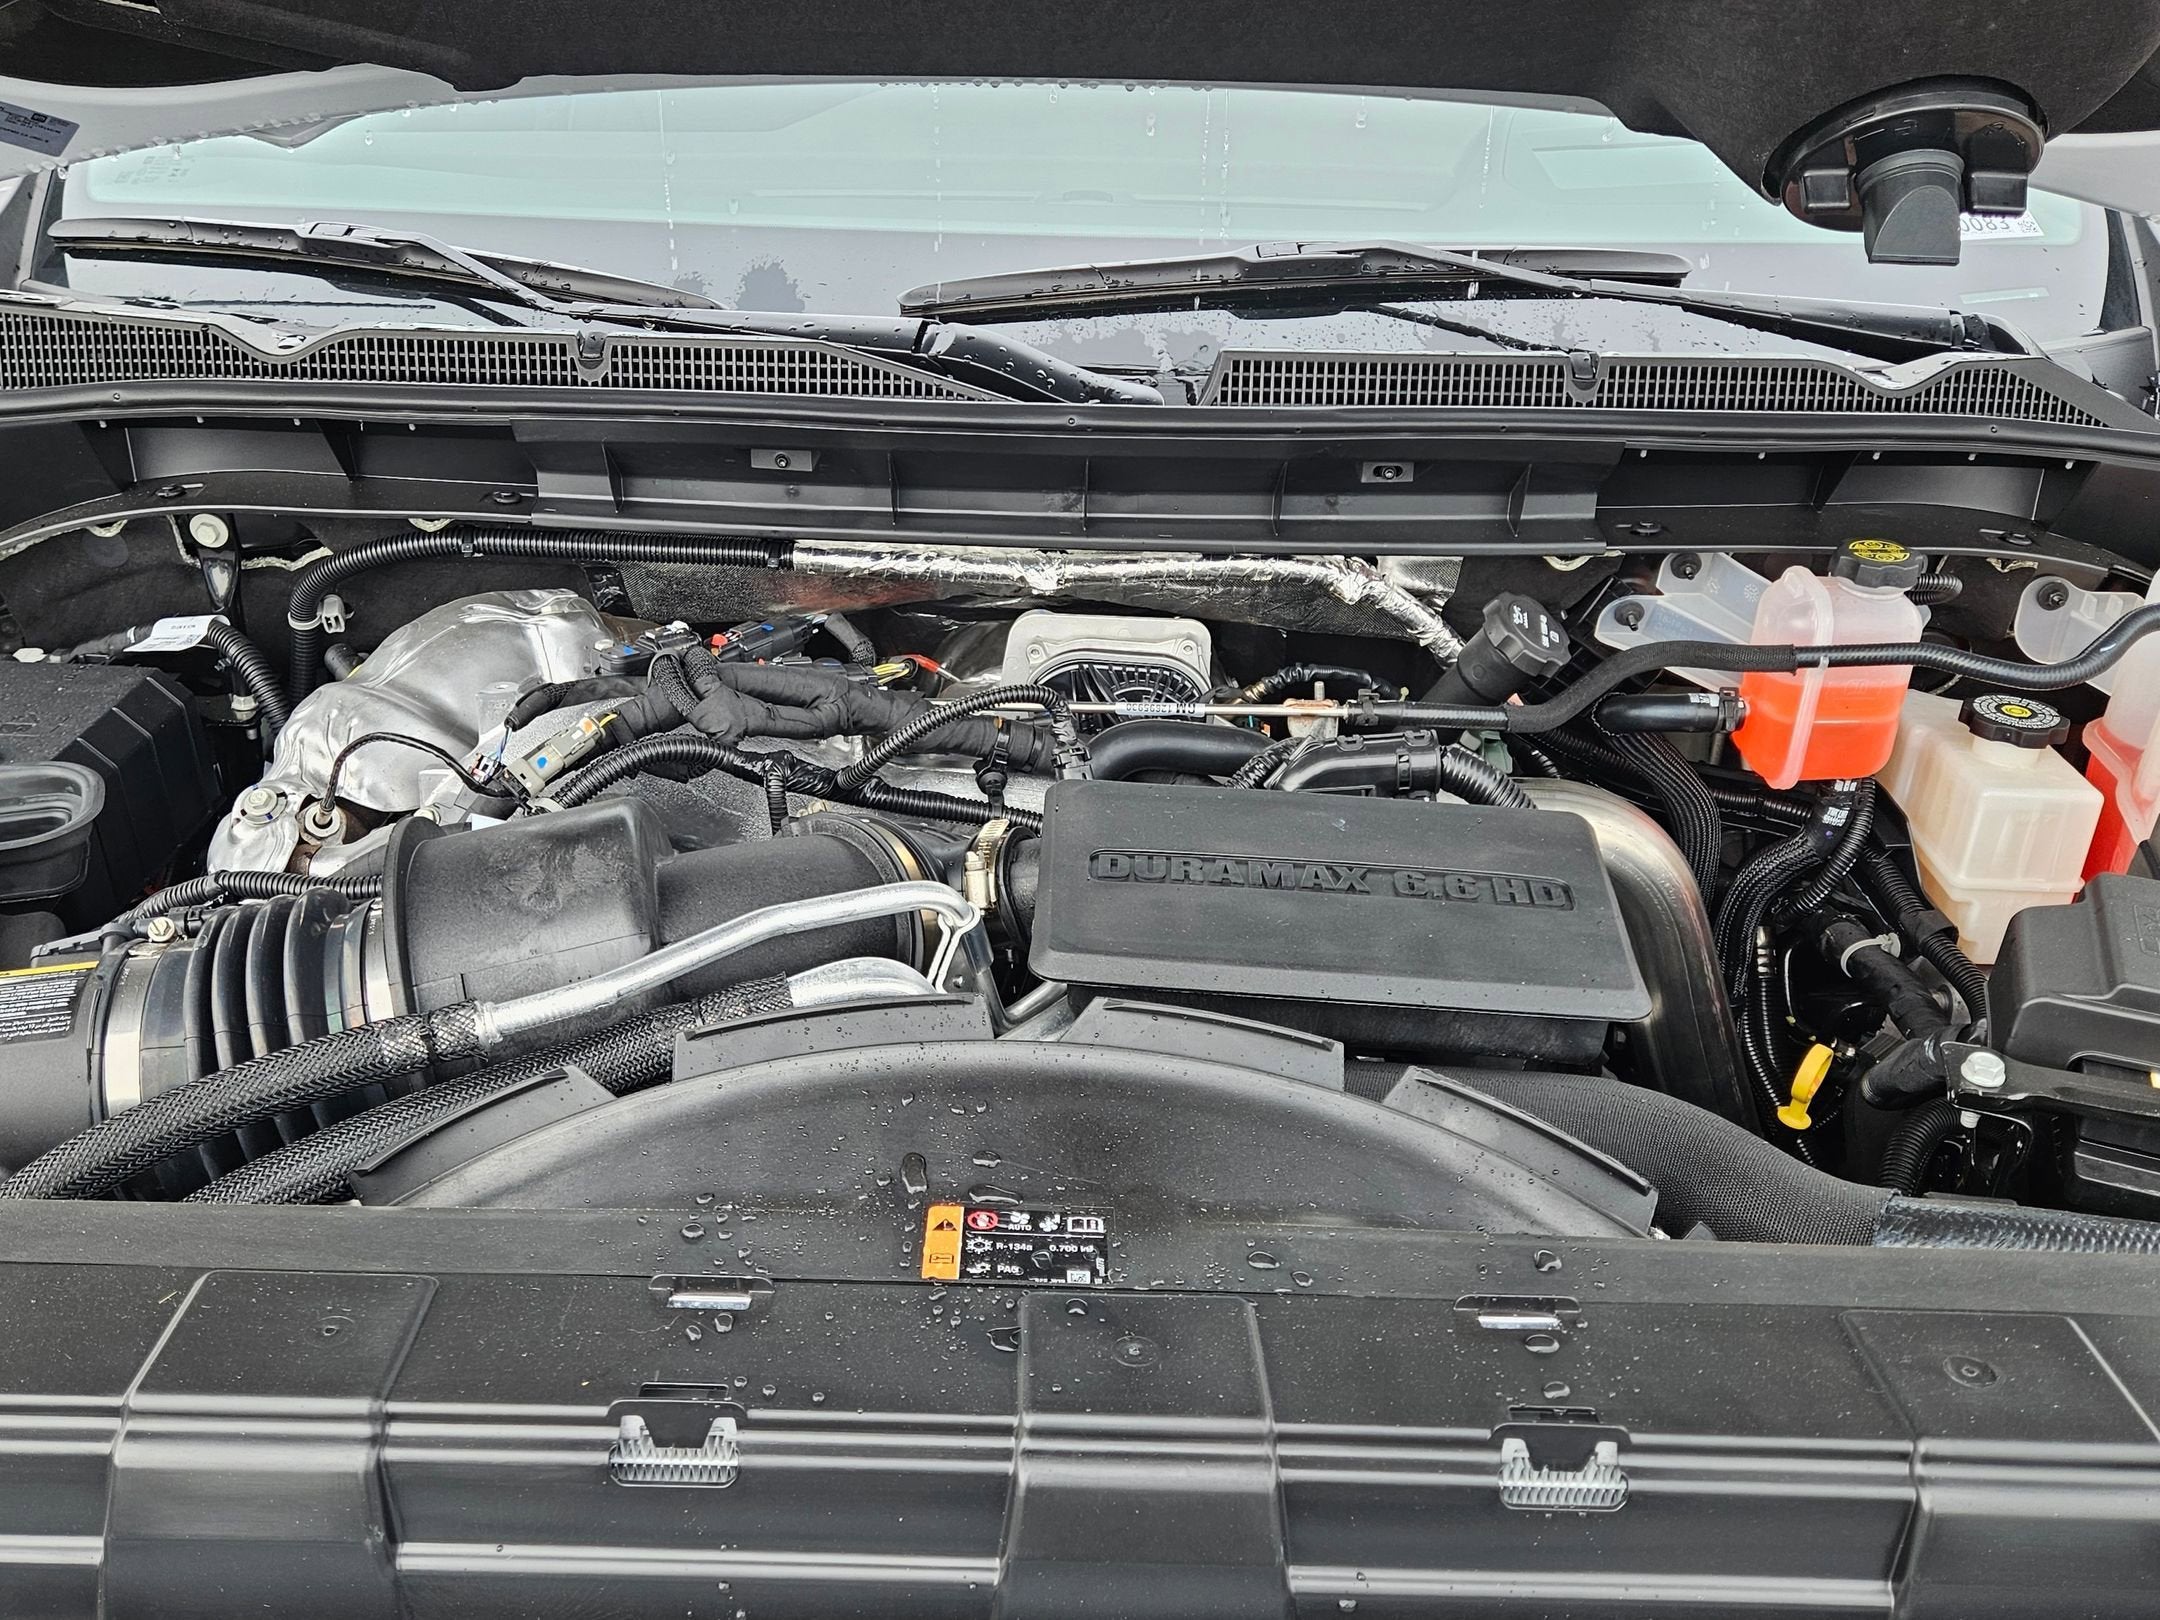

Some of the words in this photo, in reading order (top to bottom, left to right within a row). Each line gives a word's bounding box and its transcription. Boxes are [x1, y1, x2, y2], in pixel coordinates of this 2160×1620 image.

[1098, 854, 1371, 895] DURAMAX
[1392, 870, 1481, 902] 6.6
[1493, 876, 1567, 909] HD
[996, 1242, 1033, 1251] R-134a
[1049, 1244, 1079, 1253] 0.700
